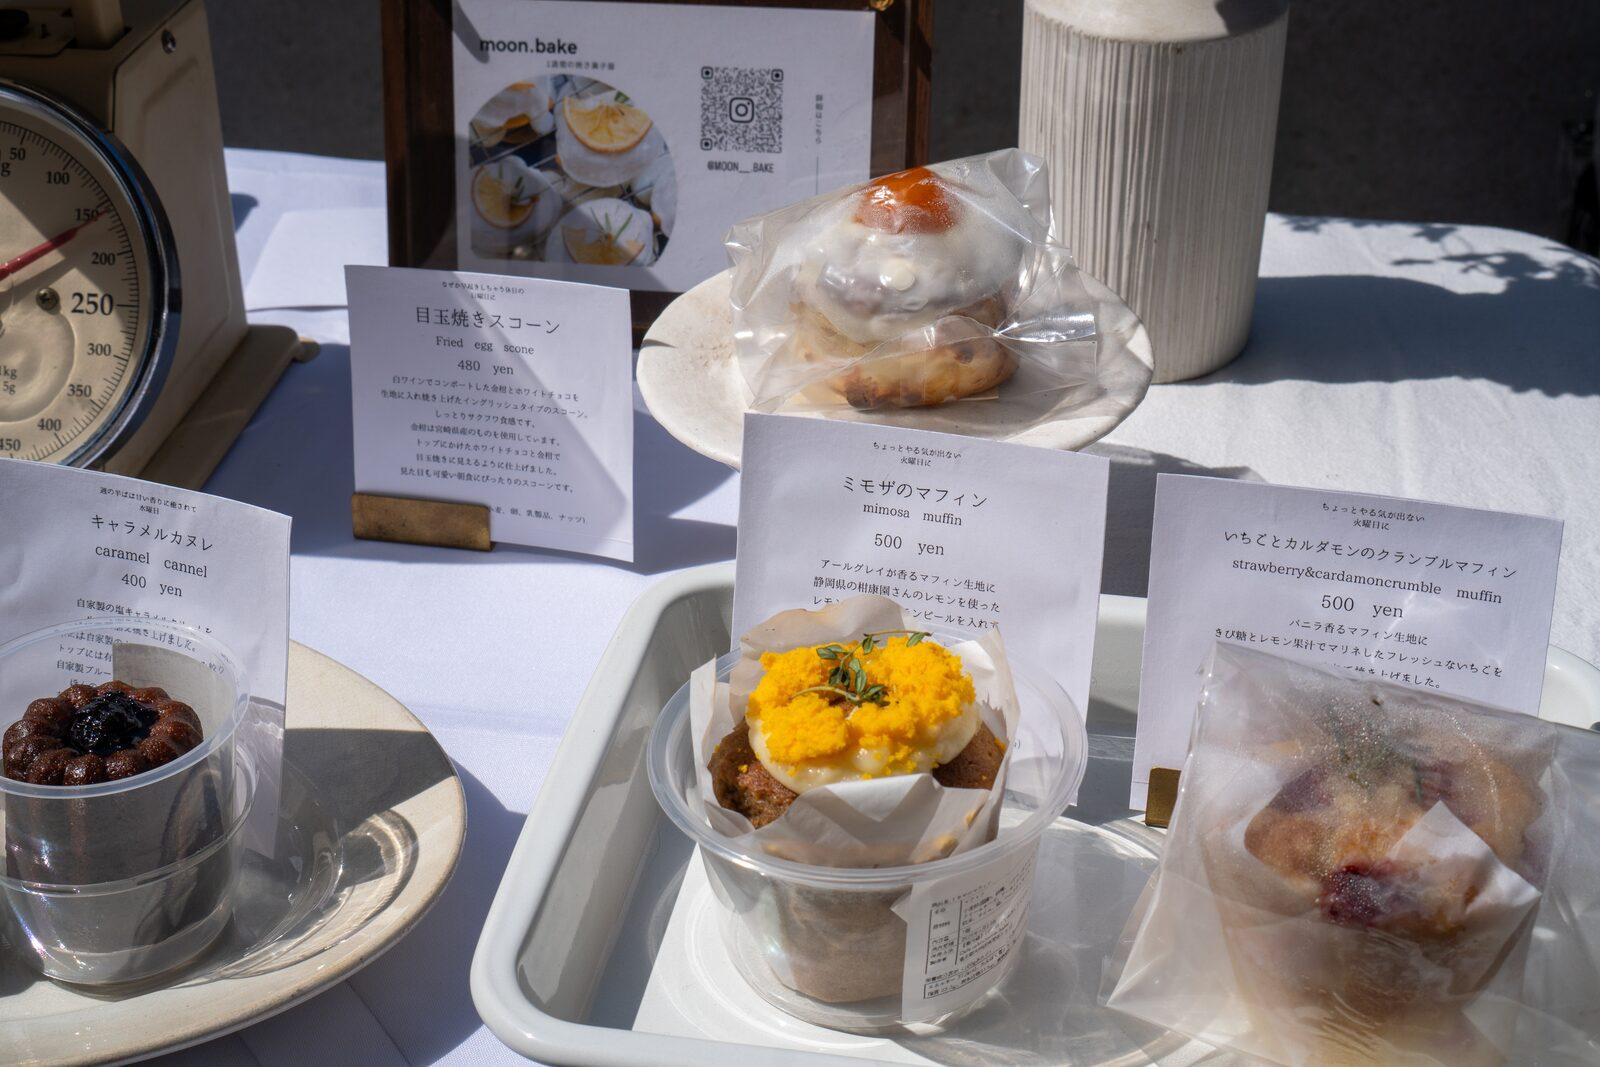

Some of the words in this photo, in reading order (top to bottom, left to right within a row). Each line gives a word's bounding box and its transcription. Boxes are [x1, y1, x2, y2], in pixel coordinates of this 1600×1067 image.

[480, 38, 577, 54] moon.bake
[10, 147, 26, 160] 50
[46, 171, 70, 185] 100
[75, 208, 99, 222] 150
[91, 252, 116, 266] 200
[71, 291, 114, 316] 250
[416, 306, 560, 335] 目玉焼きスコーン
[87, 343, 112, 356] 300
[436, 335, 464, 348] Fried
[474, 341, 493, 353] egg
[503, 344, 535, 355] scone
[457, 360, 481, 371] 480
[493, 365, 514, 375] yen
[67, 384, 92, 398] 350
[37, 418, 62, 432] 400
[873, 440, 962, 459] ちょっとやる気が出ない
[900, 456, 932, 468] 火曜日に
[842, 474, 988, 509] ミモザのマフィン
[139, 504, 160, 515] 水曜日
[862, 502, 911, 519] mimosa
[923, 509, 963, 526] muffin
[1321, 501, 1425, 522] ちょっとやる気が出ない
[91, 514, 213, 552] キャラメルカヌレ
[1352, 518, 1390, 531] 火曜日に
[874, 533, 903, 550] 500
[917, 541, 945, 557] yen
[1223, 530, 1518, 580] いちごとカルダモンのクランブルマフィン
[95, 544, 150, 565] caramel
[163, 559, 208, 578] cannel
[121, 573, 147, 589] 400
[159, 583, 183, 597] yen
[820, 558, 996, 594] アールグレイが香るマフィン生地に
[1232, 557, 1442, 596] strawberry&cardamoncrumble
[1456, 586, 1503, 604] muffin
[813, 575, 1001, 614] 静岡県の柑康園さんのレモンを使った
[1321, 595, 1355, 612] 500
[1372, 602, 1404, 619] yen
[1289, 617, 1429, 646] バニラ香るマフィン生地に
[1214, 627, 1503, 679] きび糖とレモン果汁でマリネしたフレッシュないちごを
